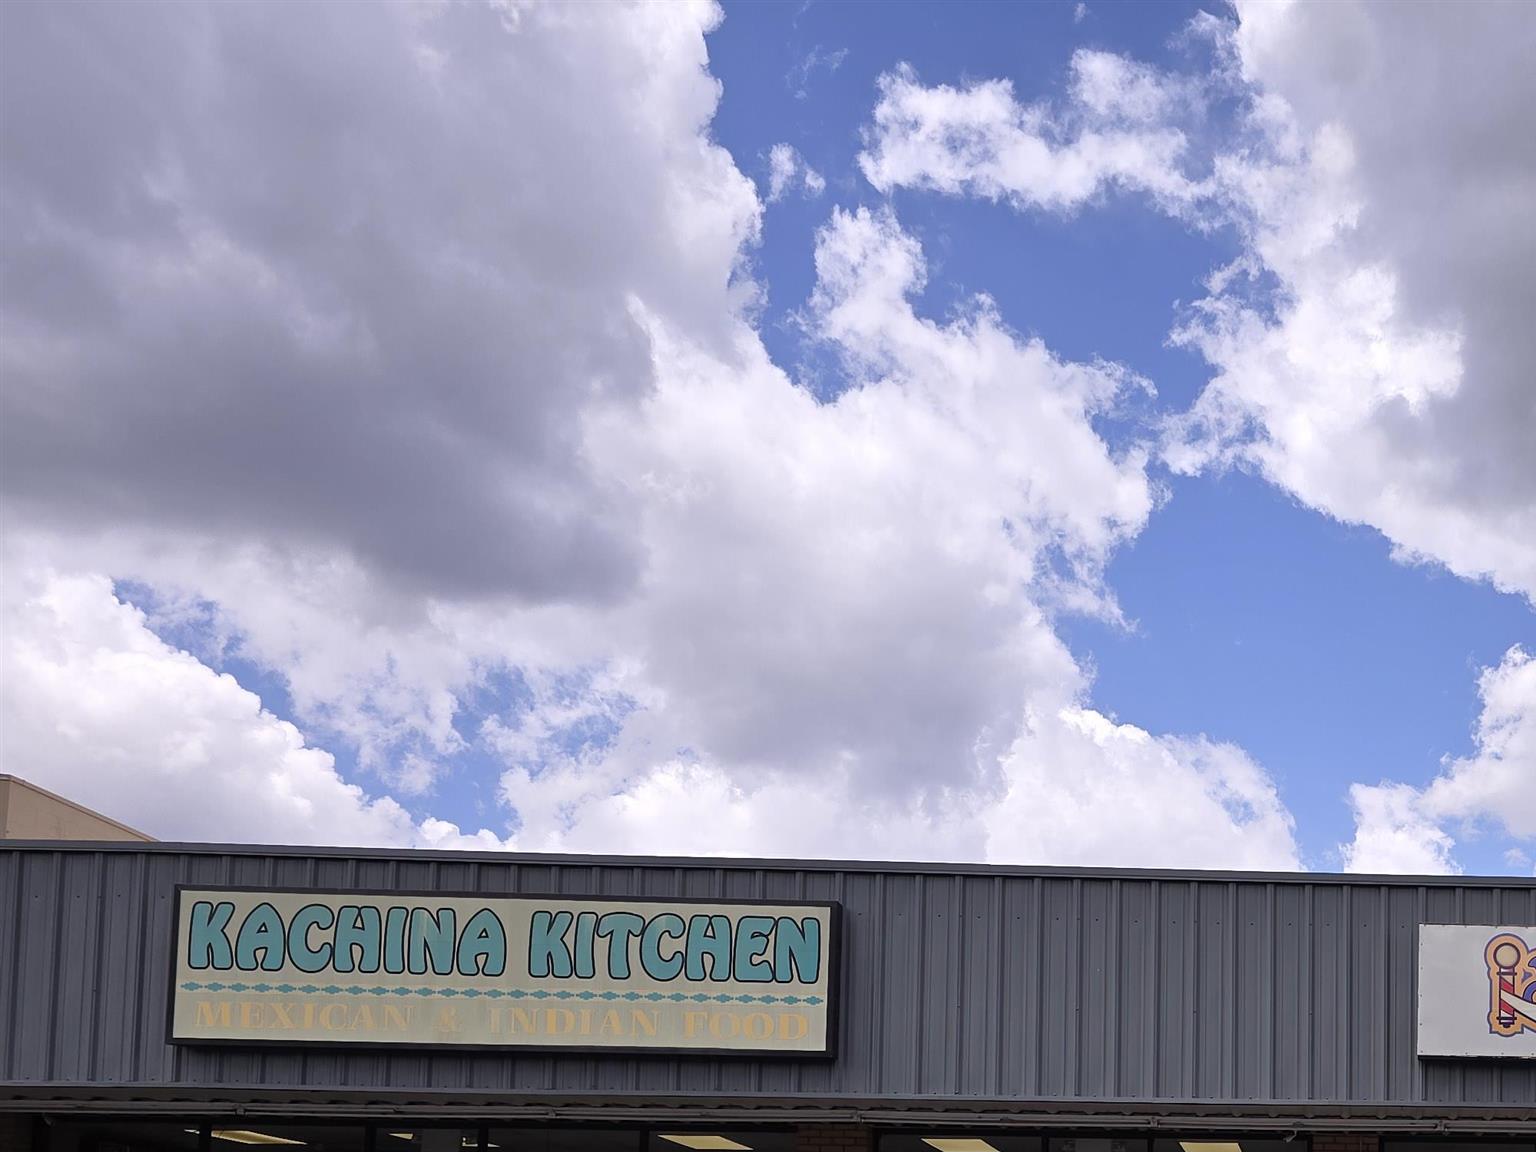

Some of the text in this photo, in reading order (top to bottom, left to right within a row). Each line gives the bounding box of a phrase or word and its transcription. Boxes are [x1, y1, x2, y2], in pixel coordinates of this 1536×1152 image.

[188, 901, 821, 984] KACHINA KITCHEN
[196, 1001, 811, 1042] MEXICAN & INDIAN FOOD
